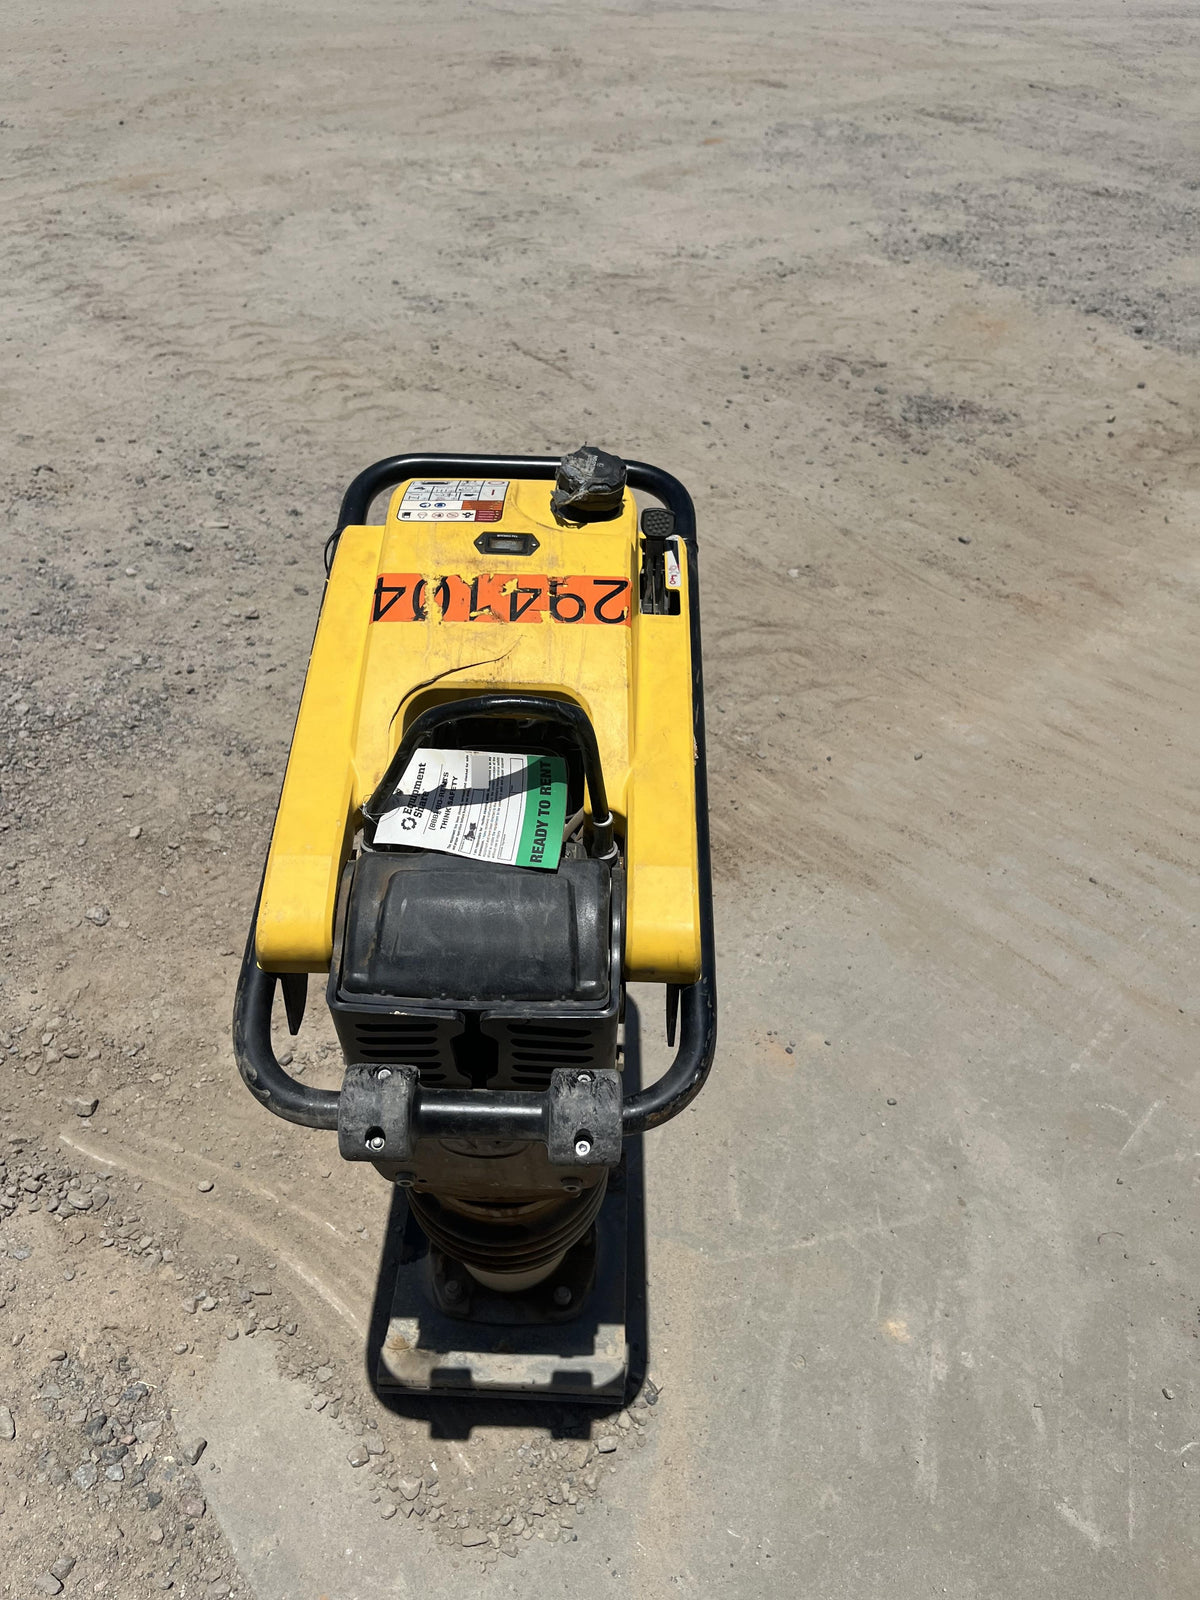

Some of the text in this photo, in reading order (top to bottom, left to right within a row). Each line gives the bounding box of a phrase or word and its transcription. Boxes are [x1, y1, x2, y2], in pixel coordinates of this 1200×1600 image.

[372, 576, 629, 624] 294104
[403, 762, 427, 815] Equipment
[413, 790, 430, 818] Share
[440, 807, 452, 830] THINK
[447, 775, 459, 806] SAFETY
[530, 761, 552, 863] READY TO RENT
